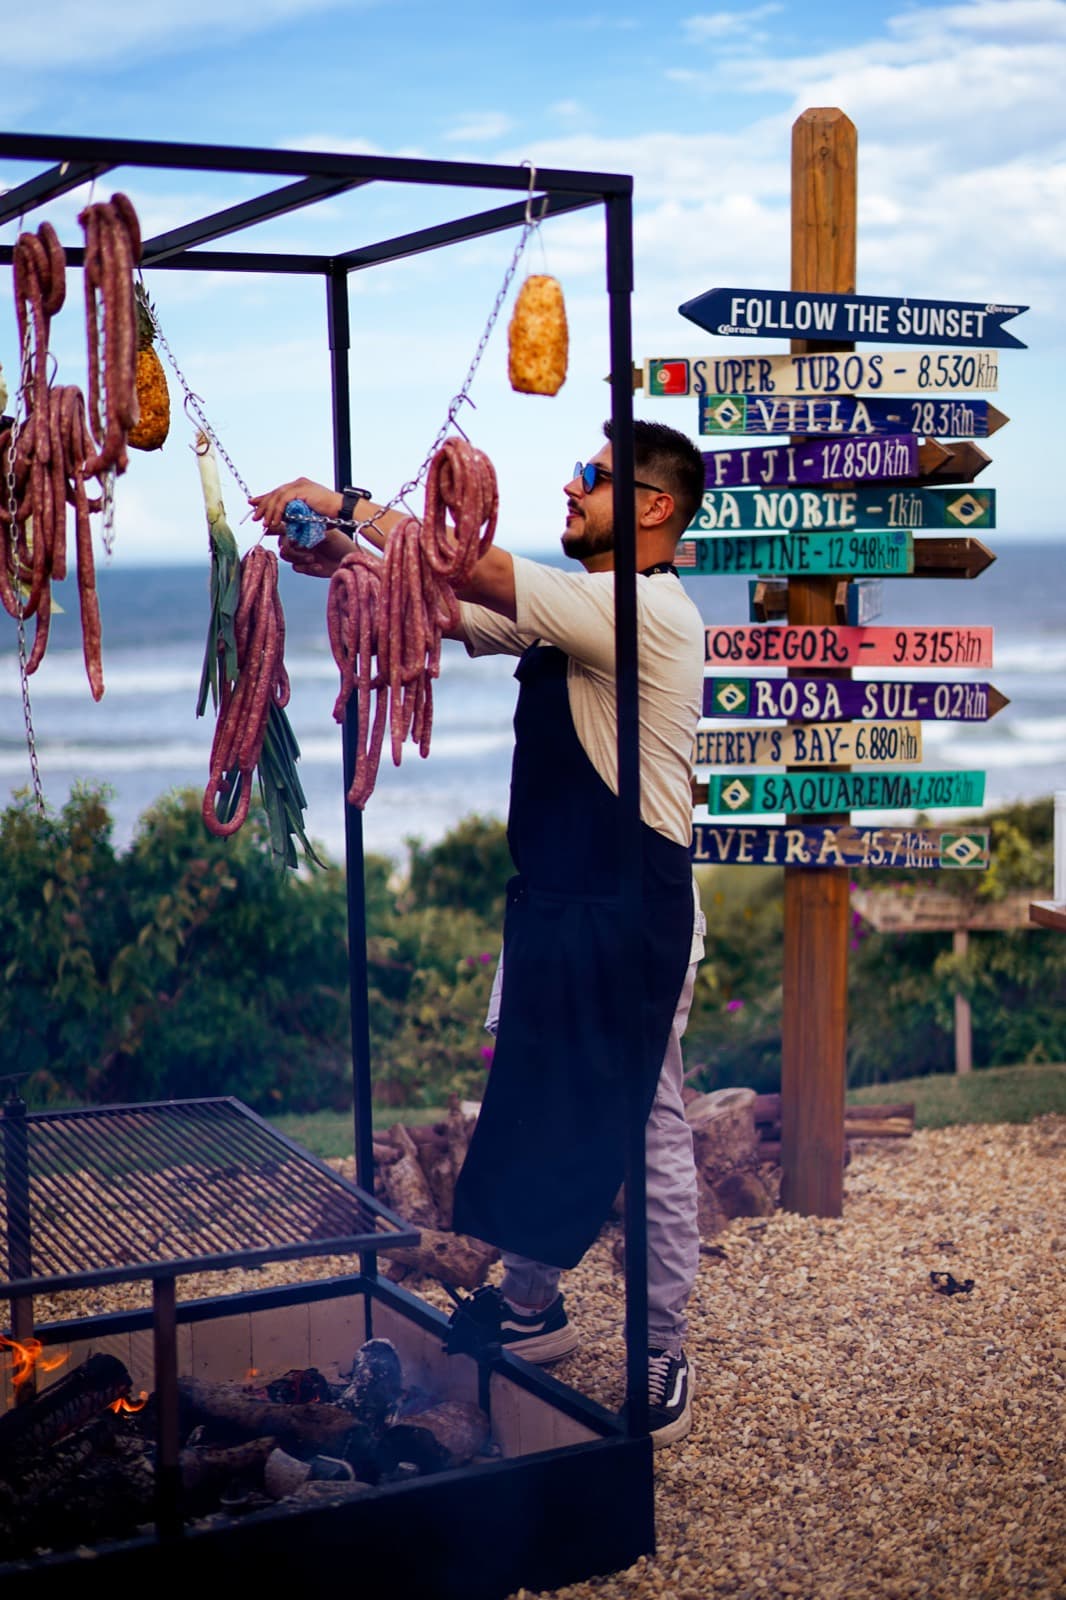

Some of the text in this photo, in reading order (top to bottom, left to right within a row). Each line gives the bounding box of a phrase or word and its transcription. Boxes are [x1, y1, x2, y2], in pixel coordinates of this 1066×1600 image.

[731, 297, 987, 338] FOLLOW THE SUNSET
[693, 358, 775, 394] SUPER
[791, 355, 883, 392] TUBOS
[755, 398, 876, 434] VILLA
[688, 492, 742, 529] SA
[753, 492, 857, 528] NORTE
[755, 680, 843, 720] ROSA
[690, 730, 782, 764] EFFREY'S
